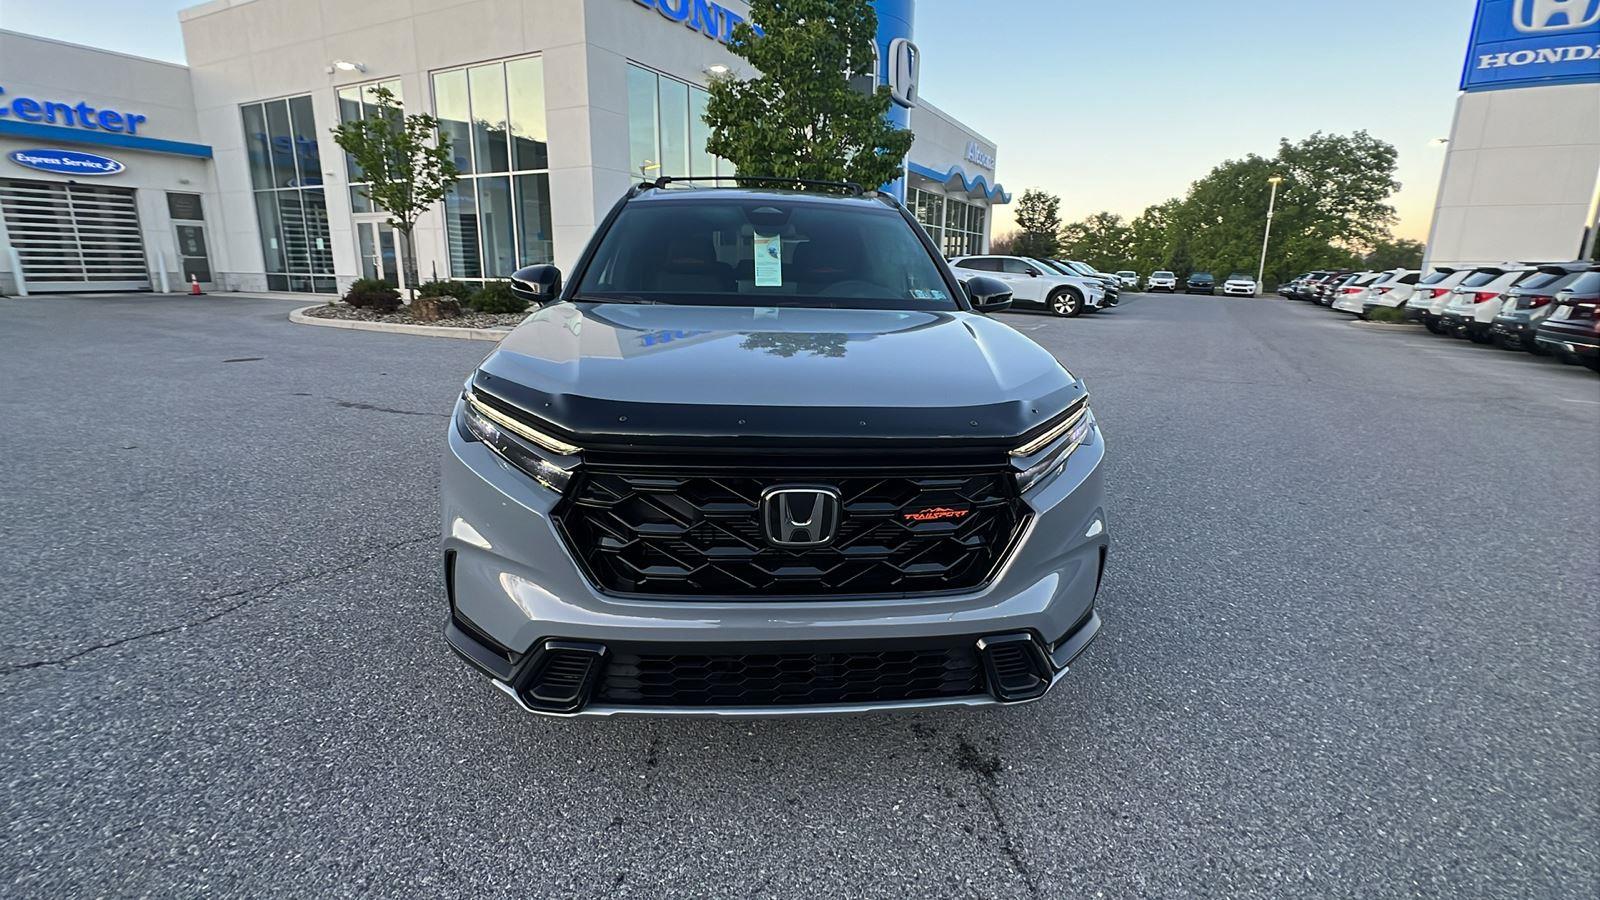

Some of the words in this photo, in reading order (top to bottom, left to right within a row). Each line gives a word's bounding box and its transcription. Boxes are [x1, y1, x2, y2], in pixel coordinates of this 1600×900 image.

[0, 86, 146, 134] enter
[16, 153, 61, 165] Express
[61, 157, 103, 168] Service
[904, 510, 969, 520] TRAILSPORT
